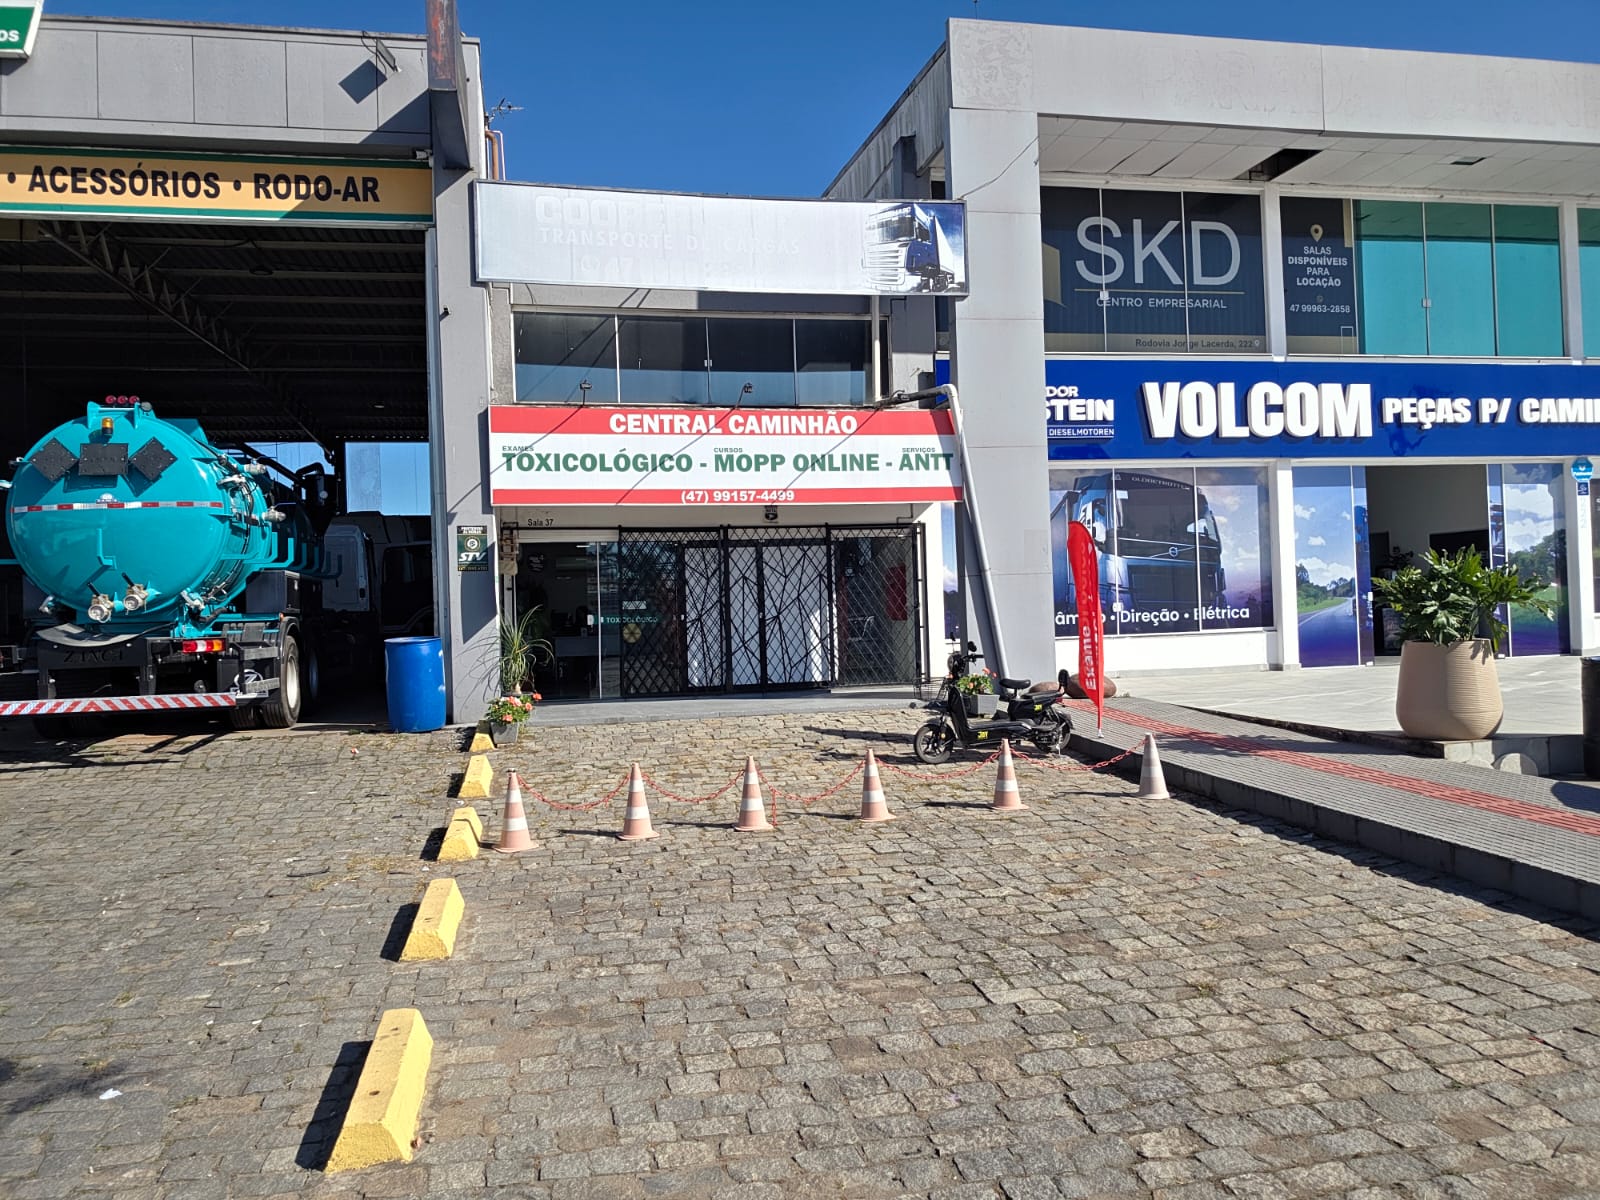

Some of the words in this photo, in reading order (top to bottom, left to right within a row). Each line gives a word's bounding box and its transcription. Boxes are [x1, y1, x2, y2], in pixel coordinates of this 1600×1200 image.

[28, 162, 220, 199] ACESSÓRIOS
[253, 172, 380, 202] RODO-AR
[1075, 216, 1241, 286] SKD
[1303, 246, 1332, 255] SALAS
[1287, 255, 1348, 266] DISPONÍVEIS
[1306, 267, 1330, 276] PARA
[1296, 277, 1342, 288] LOCAÇÃO
[1096, 297, 1143, 307] CENTRO
[1148, 298, 1228, 309] EMPRESARIAL
[1289, 304, 1300, 312] 47
[1135, 338, 1170, 348] Rodovia
[1046, 386, 1079, 398] DOR
[1142, 381, 1373, 439] VOLCOM
[1382, 397, 1472, 430] PEÇAS
[1477, 397, 1512, 424] P/
[609, 413, 723, 434] CENTRAL
[728, 411, 858, 434] CAMINHÃO
[1049, 427, 1115, 436] DIESELMOTOREN
[502, 447, 693, 473] TOXICOLÓGICO
[714, 453, 786, 472] MOPP
[792, 453, 880, 472] ONLINE
[899, 453, 954, 471] ANTT
[681, 490, 709, 504] (47)
[713, 489, 795, 502] 99157-4499
[527, 518, 544, 527] Sala
[545, 518, 555, 527] 37
[459, 552, 487, 562] STV
[1120, 607, 1179, 625] Direção
[1193, 605, 1250, 621] Elétrica
[1083, 625, 1096, 691] Exame
